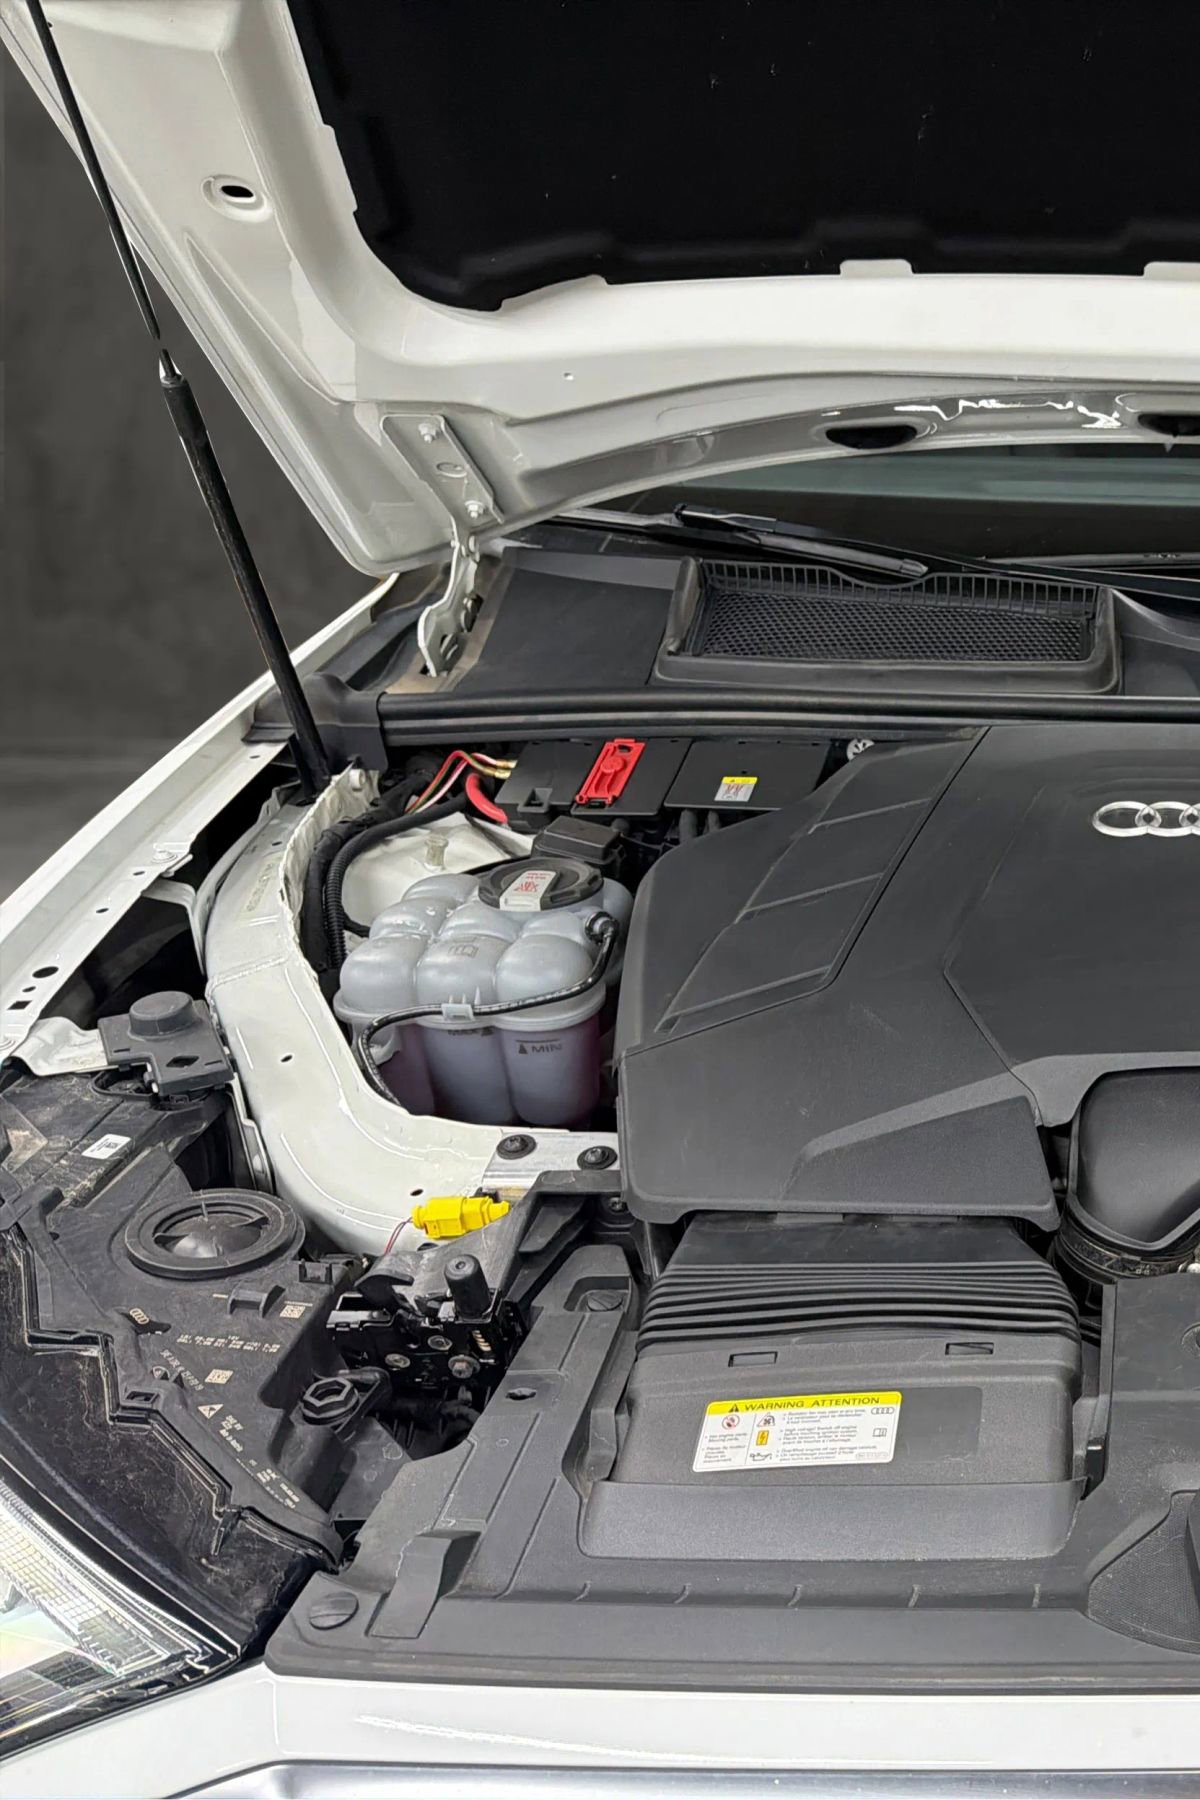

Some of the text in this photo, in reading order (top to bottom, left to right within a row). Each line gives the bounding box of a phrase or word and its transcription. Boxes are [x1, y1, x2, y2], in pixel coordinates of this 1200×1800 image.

[531, 1043, 562, 1053] MIN
[744, 1397, 880, 1411] WARNING ATTENTION
